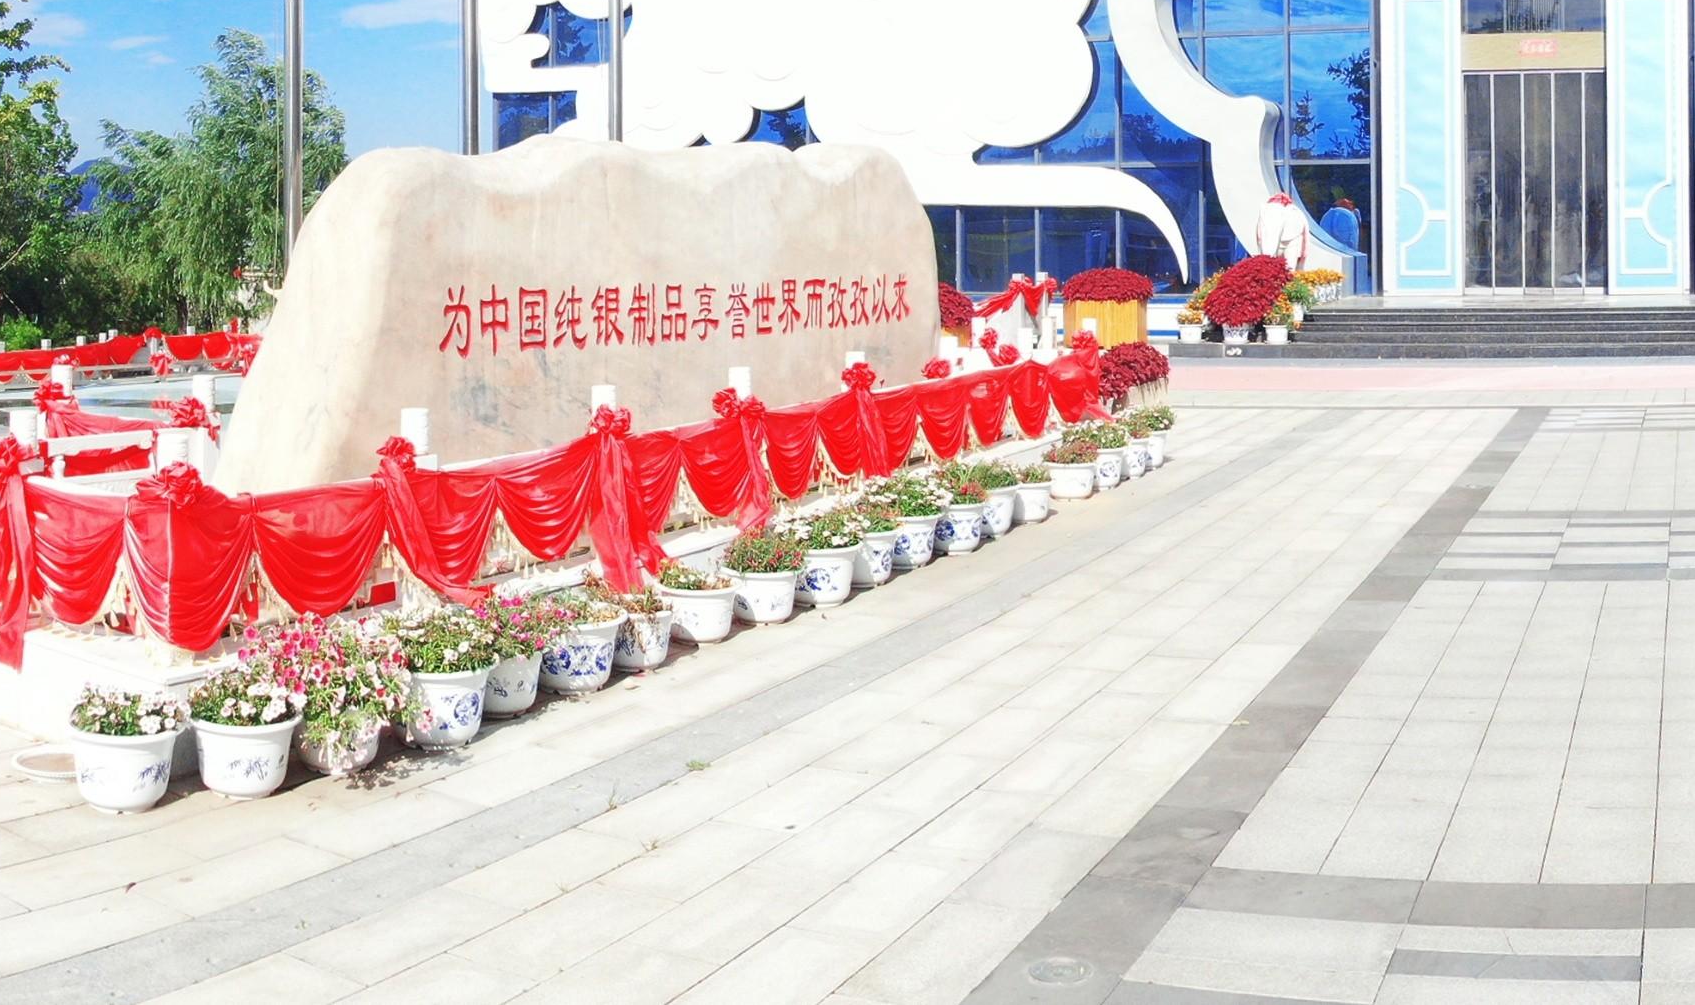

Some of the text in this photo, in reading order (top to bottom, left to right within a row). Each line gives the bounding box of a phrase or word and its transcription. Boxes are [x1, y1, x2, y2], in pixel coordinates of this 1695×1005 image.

[438, 272, 911, 359] 为中国纯银制品享誉世界而孜孜以求
